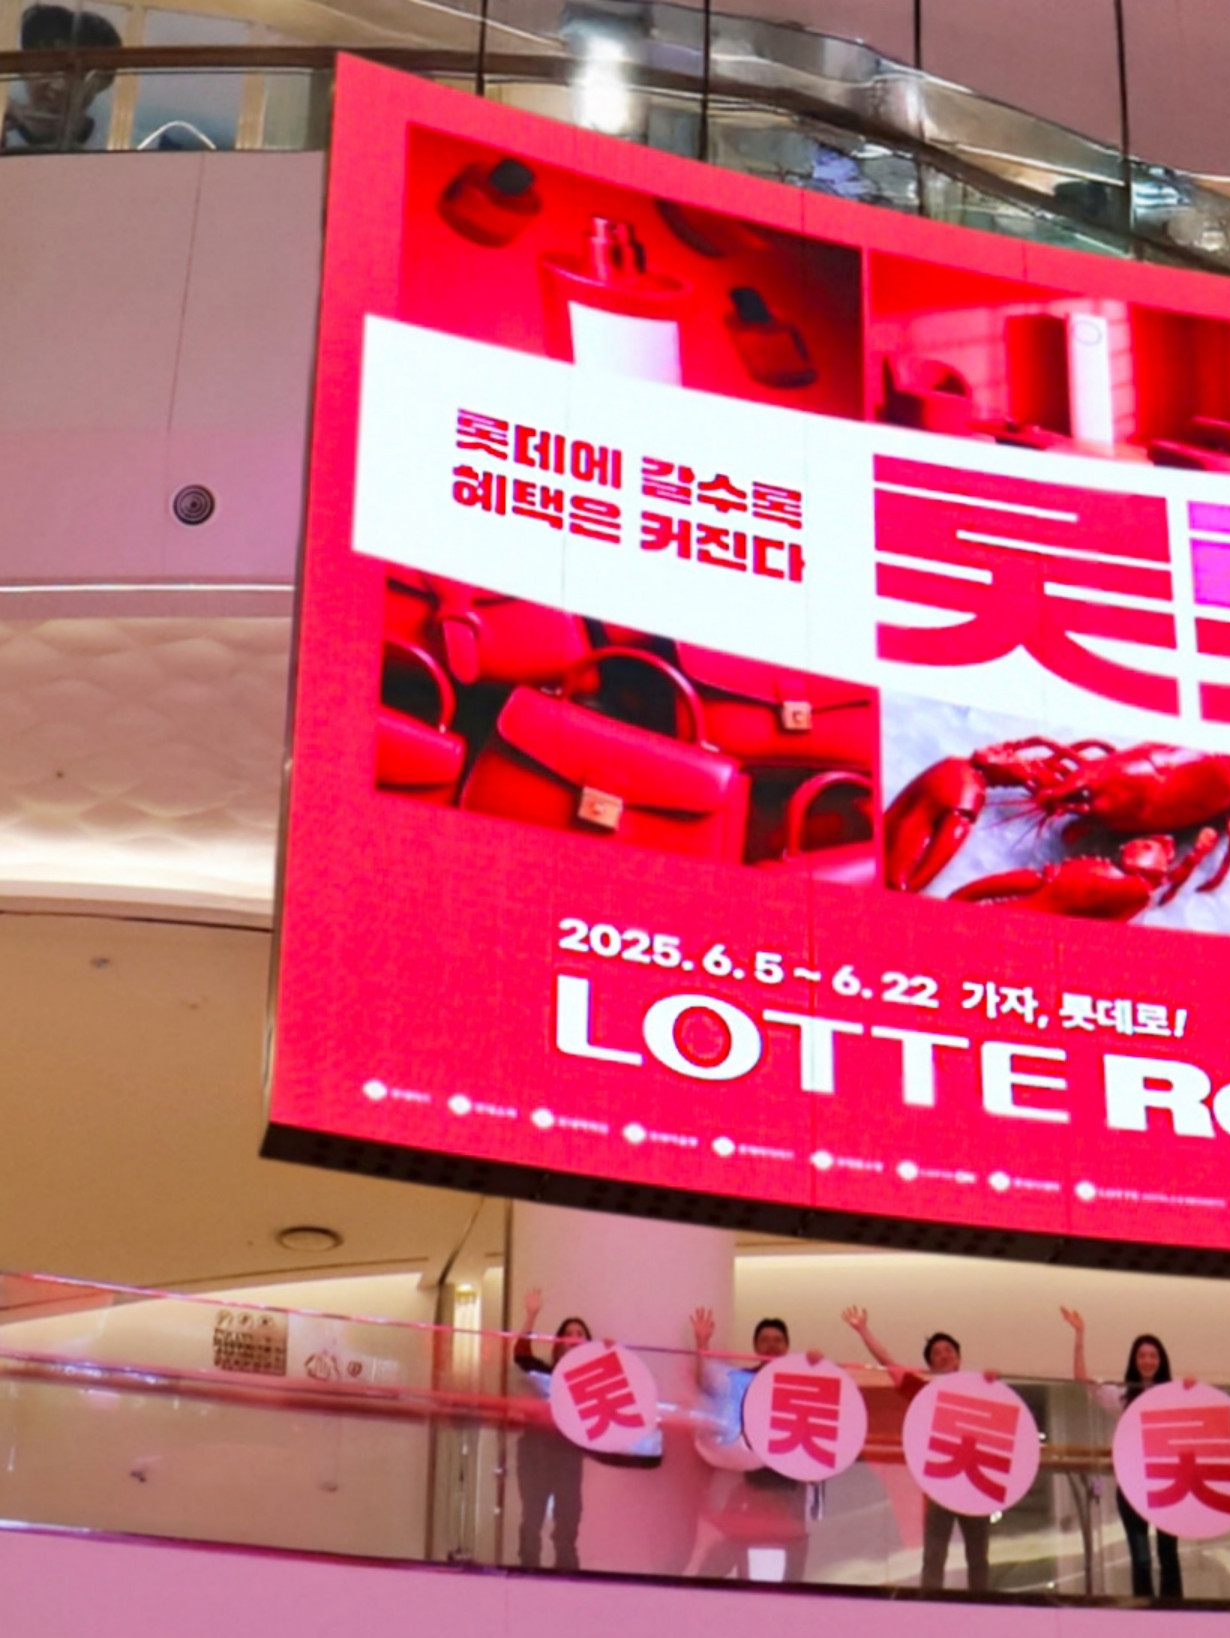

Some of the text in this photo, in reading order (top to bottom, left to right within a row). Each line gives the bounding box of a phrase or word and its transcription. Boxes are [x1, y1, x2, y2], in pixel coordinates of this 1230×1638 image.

[452, 464, 806, 583] 혜택은 커진다
[456, 409, 803, 530] 롯데에 갈수록
[556, 974, 1070, 1123] LOTTE
[961, 981, 1050, 1030] 가자,
[1058, 992, 1188, 1038] 롯데로!
